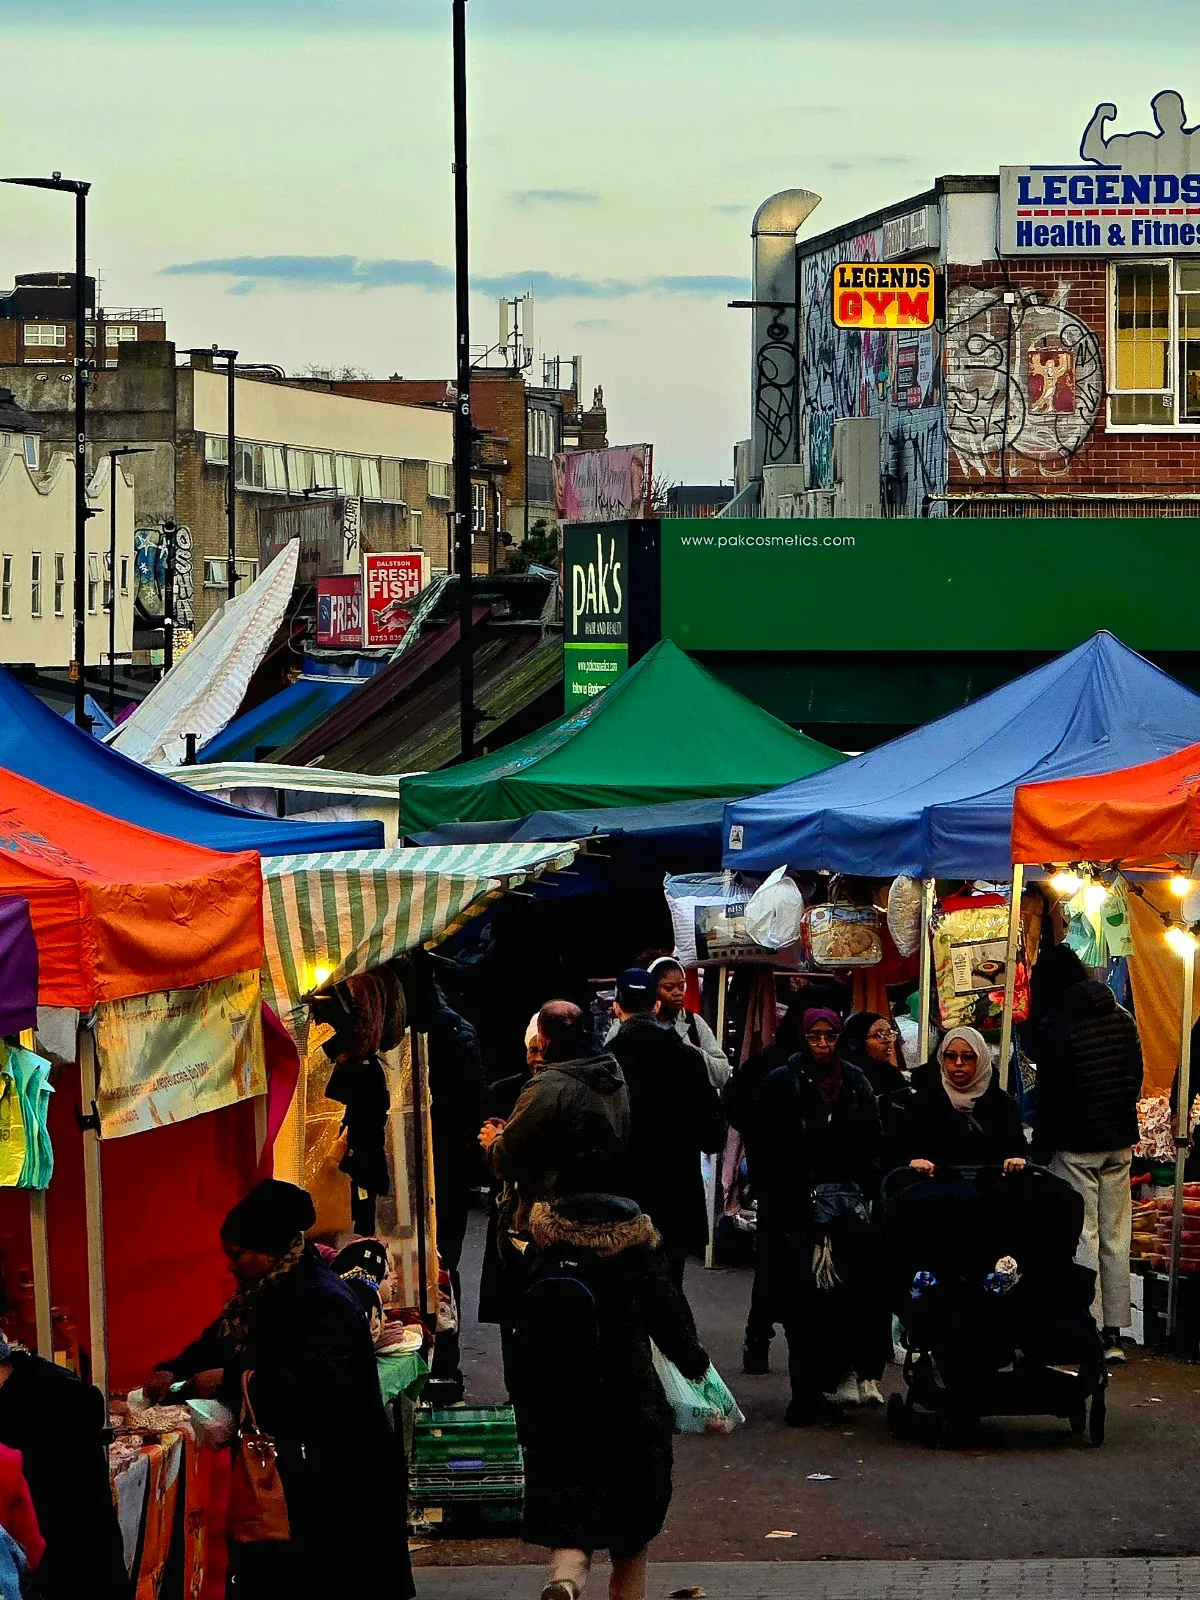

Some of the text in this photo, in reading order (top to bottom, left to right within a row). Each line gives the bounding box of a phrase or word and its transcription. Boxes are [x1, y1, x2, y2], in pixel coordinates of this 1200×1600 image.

[1017, 174, 1200, 206] LEGENDS
[1016, 220, 1101, 247] Health
[1107, 223, 1126, 246] &
[838, 267, 931, 288] LEGENDS
[838, 291, 930, 325] GYM
[680, 534, 856, 549] www.pakcosmetics.com
[369, 568, 419, 581] FRESH
[369, 580, 420, 599] FISH
